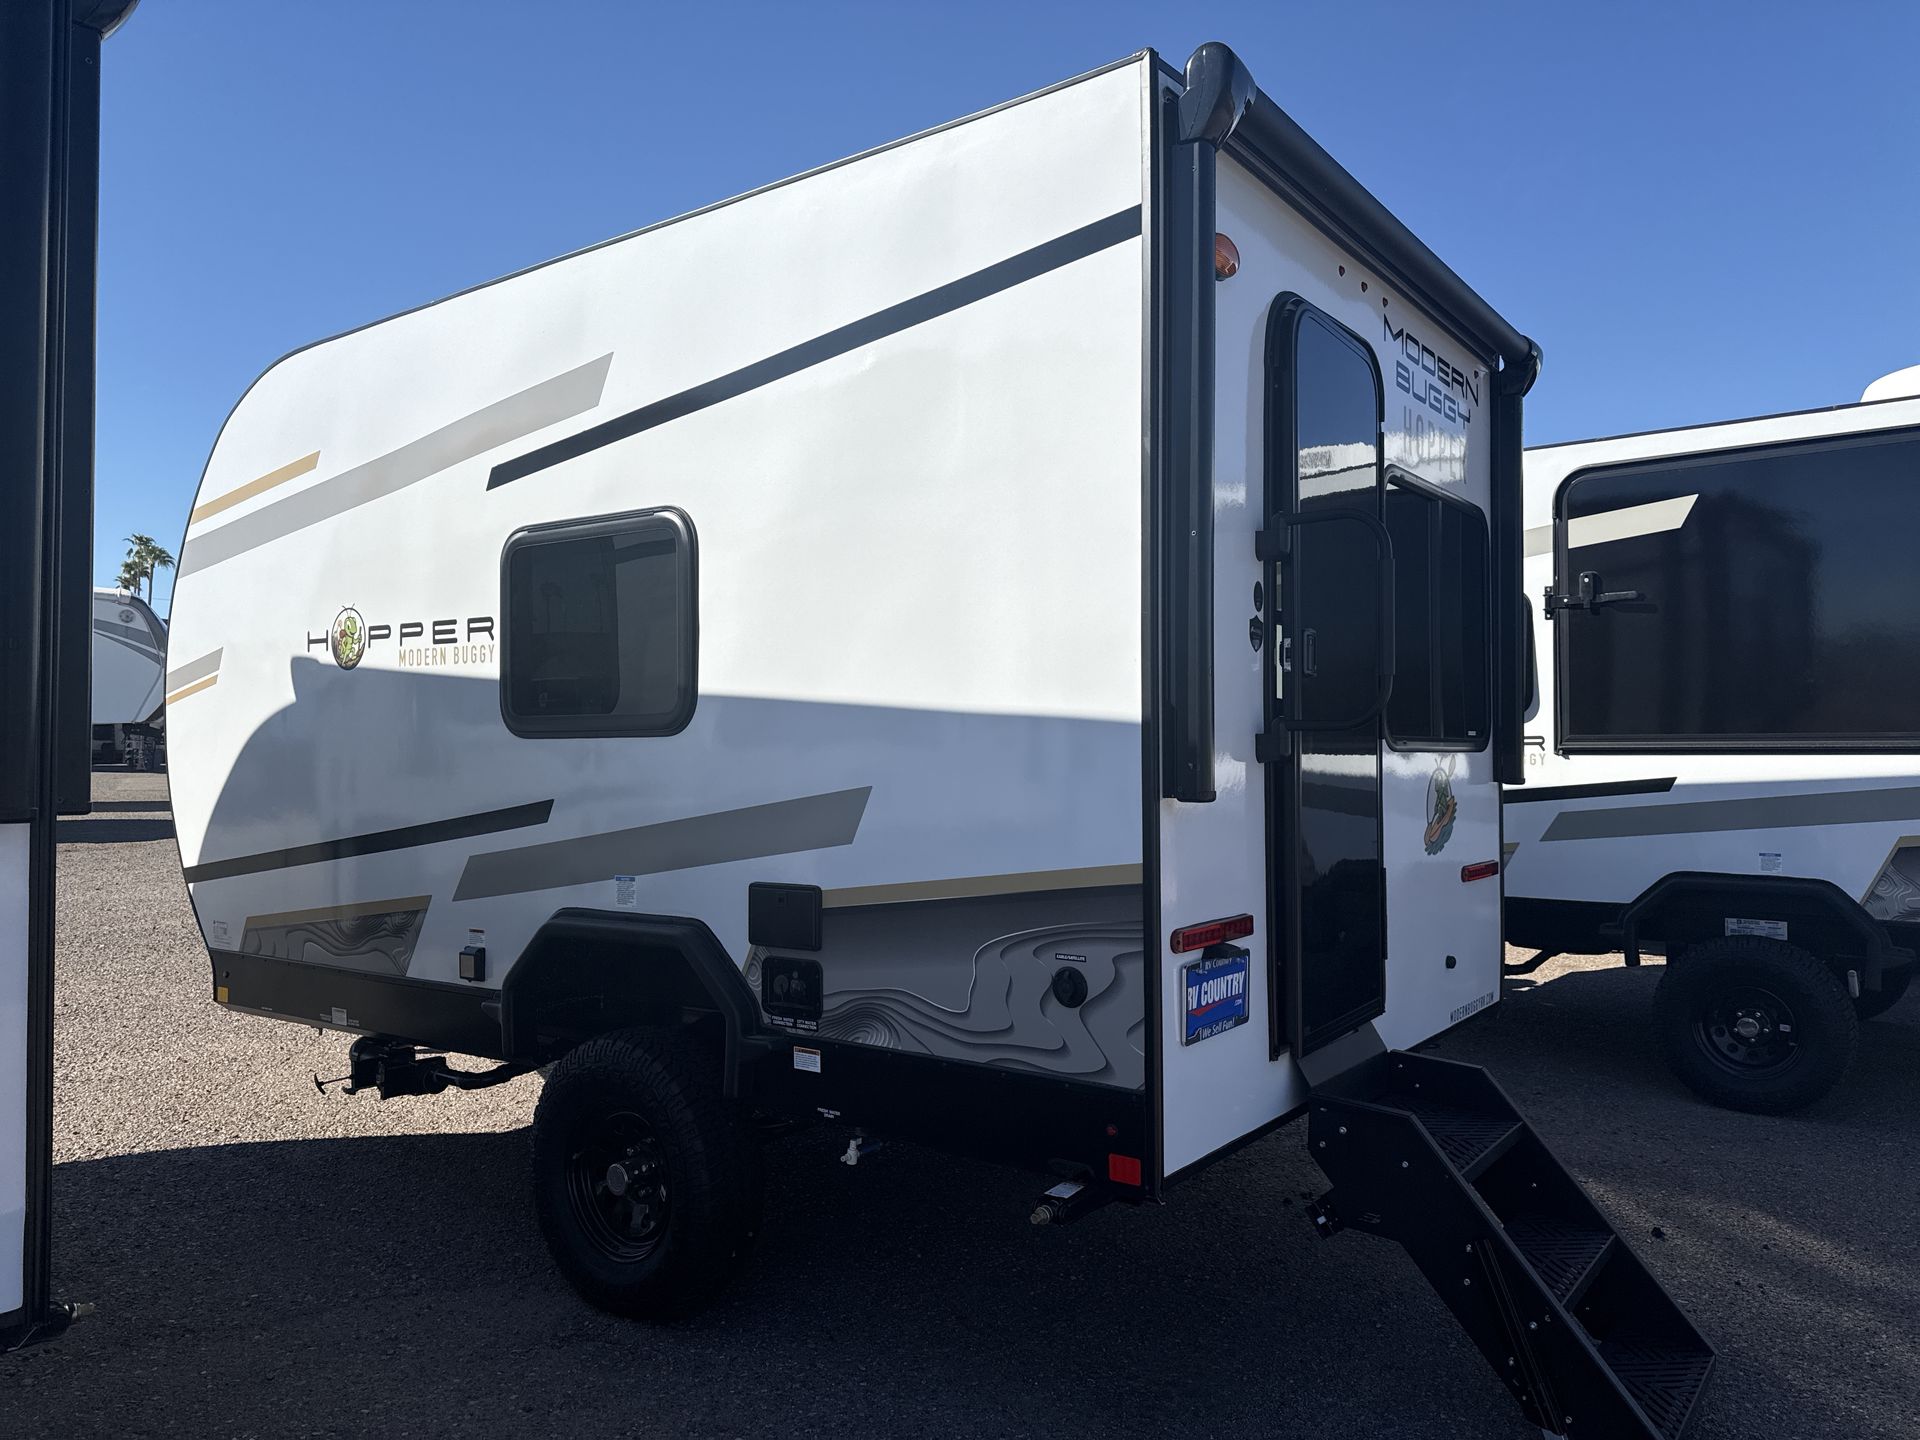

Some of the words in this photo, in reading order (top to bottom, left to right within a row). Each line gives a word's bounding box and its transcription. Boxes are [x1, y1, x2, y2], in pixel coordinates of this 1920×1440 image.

[1384, 313, 1479, 408] MODERN
[1396, 360, 1471, 430] BUGGY
[399, 647, 447, 667] MODERN
[453, 644, 495, 664] BUGGY
[1187, 985, 1199, 1011] RV
[1201, 971, 1245, 1006] COUNTRY
